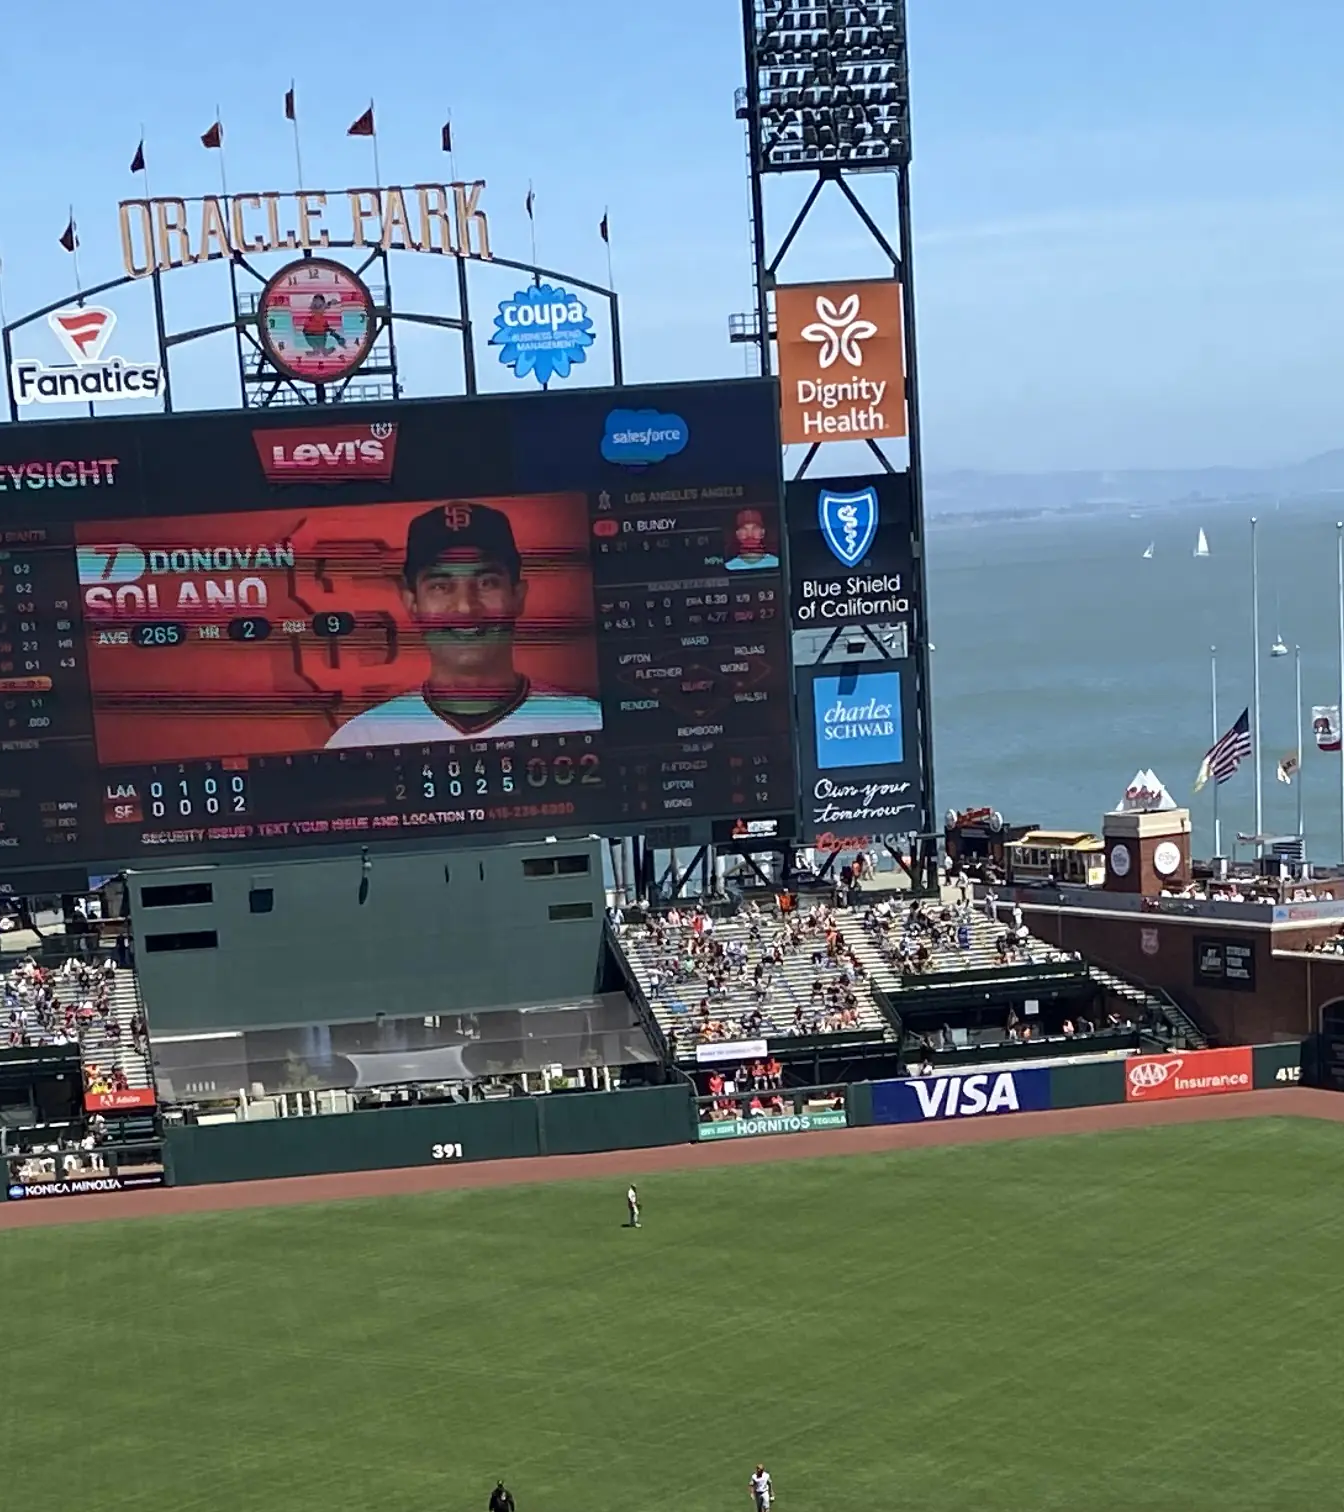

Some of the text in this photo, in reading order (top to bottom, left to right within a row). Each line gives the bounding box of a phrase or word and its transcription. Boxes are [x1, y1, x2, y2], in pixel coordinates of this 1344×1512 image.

[118, 179, 493, 278] ORACLE PARK
[307, 267, 320, 280] 12
[504, 300, 584, 332] coupa
[17, 361, 158, 398] Fanatics
[797, 376, 887, 409] Dignity
[803, 408, 885, 435] Health
[613, 427, 682, 446] salesforce
[637, 518, 677, 532] BUNDY
[150, 543, 294, 574] DONOVAN
[803, 574, 901, 599] Blue Shield
[798, 596, 909, 620] of California
[243, 621, 256, 638] 2
[327, 616, 340, 632] 9
[824, 698, 892, 723] charles
[824, 721, 895, 740] SCHWAB
[108, 784, 137, 799] LAA
[151, 781, 163, 797] 0
[179, 780, 188, 796] 1
[206, 778, 217, 794] 0
[232, 776, 244, 792] 0
[581, 753, 601, 784] 2
[115, 776, 514, 819] SF 0 0 0 2 2 3 0 2 5
[403, 811, 466, 825] LOCATION
[469, 809, 485, 821] TO
[1175, 1072, 1248, 1090] Insurance
[906, 1073, 1019, 1118] VISA
[736, 1116, 810, 1135] HORNITOS
[432, 1144, 462, 1158] 391
[25, 1182, 70, 1196] KONICA
[72, 1177, 122, 1193] MINOLTA
